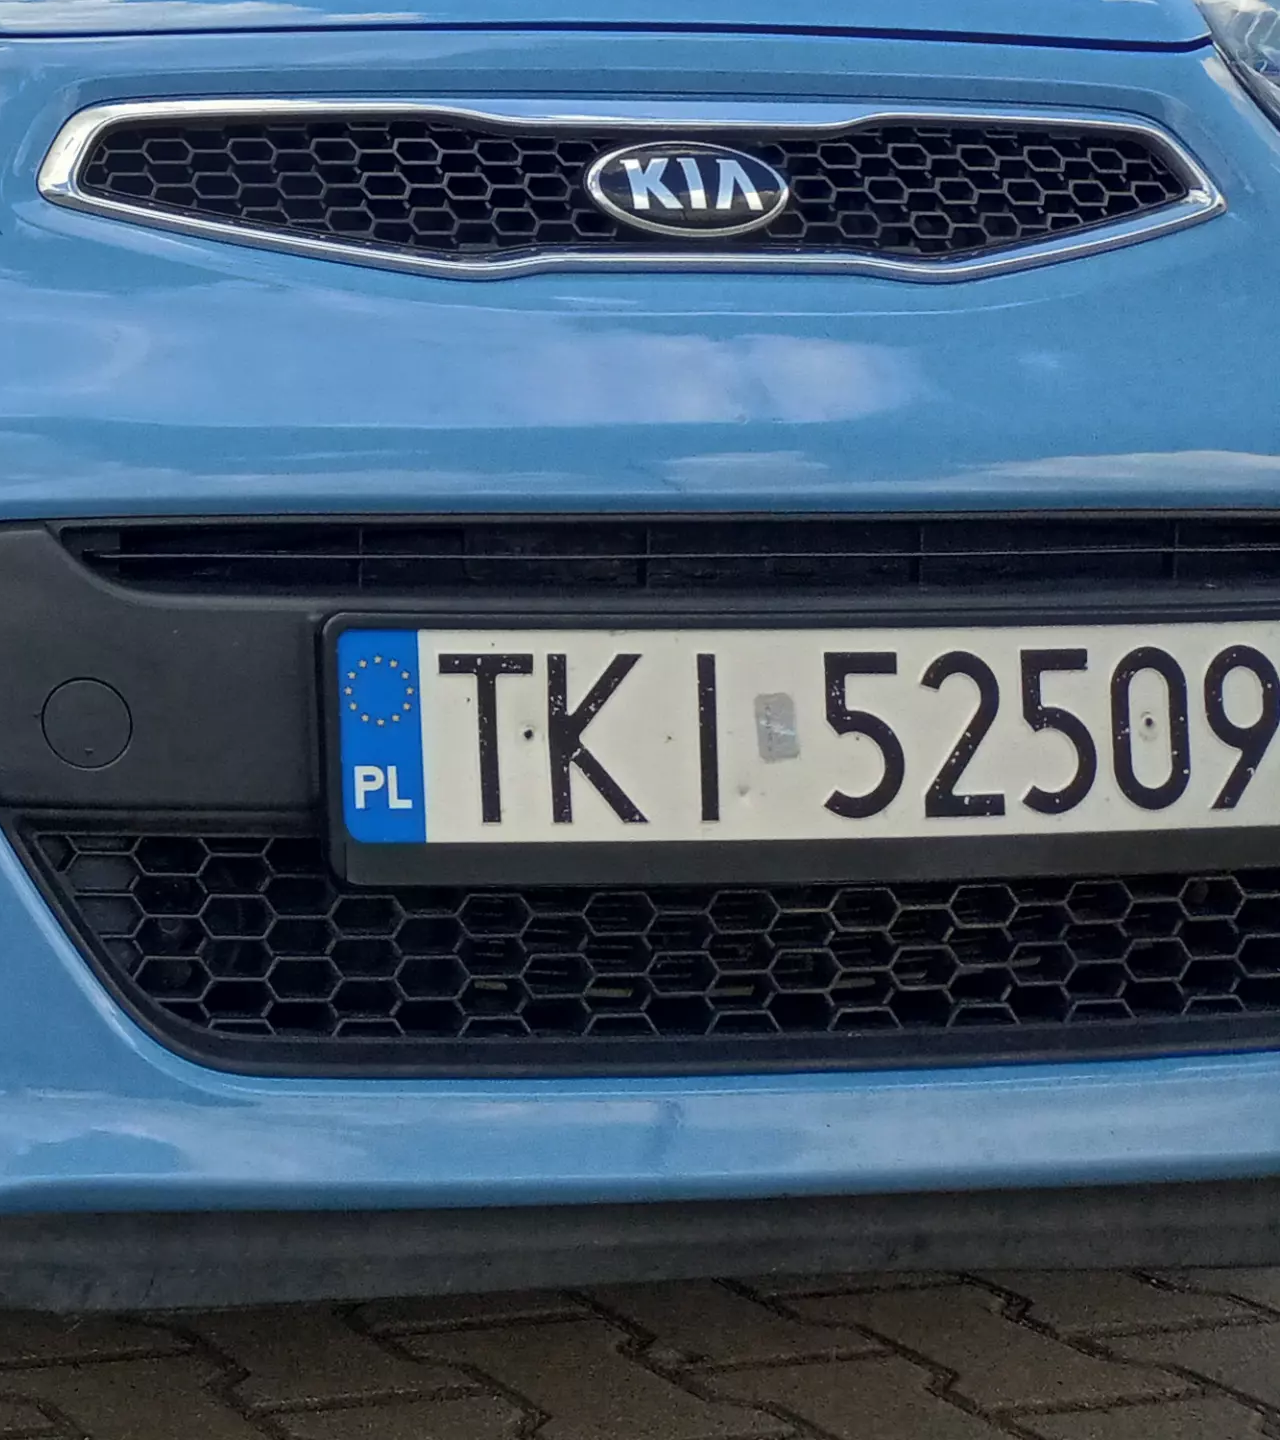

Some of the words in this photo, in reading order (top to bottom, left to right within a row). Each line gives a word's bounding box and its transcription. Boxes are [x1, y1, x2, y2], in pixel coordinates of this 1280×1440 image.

[619, 157, 764, 210] KIA
[438, 652, 722, 825] TKI
[823, 644, 1280, 819] 52509
[353, 765, 413, 811] PL
